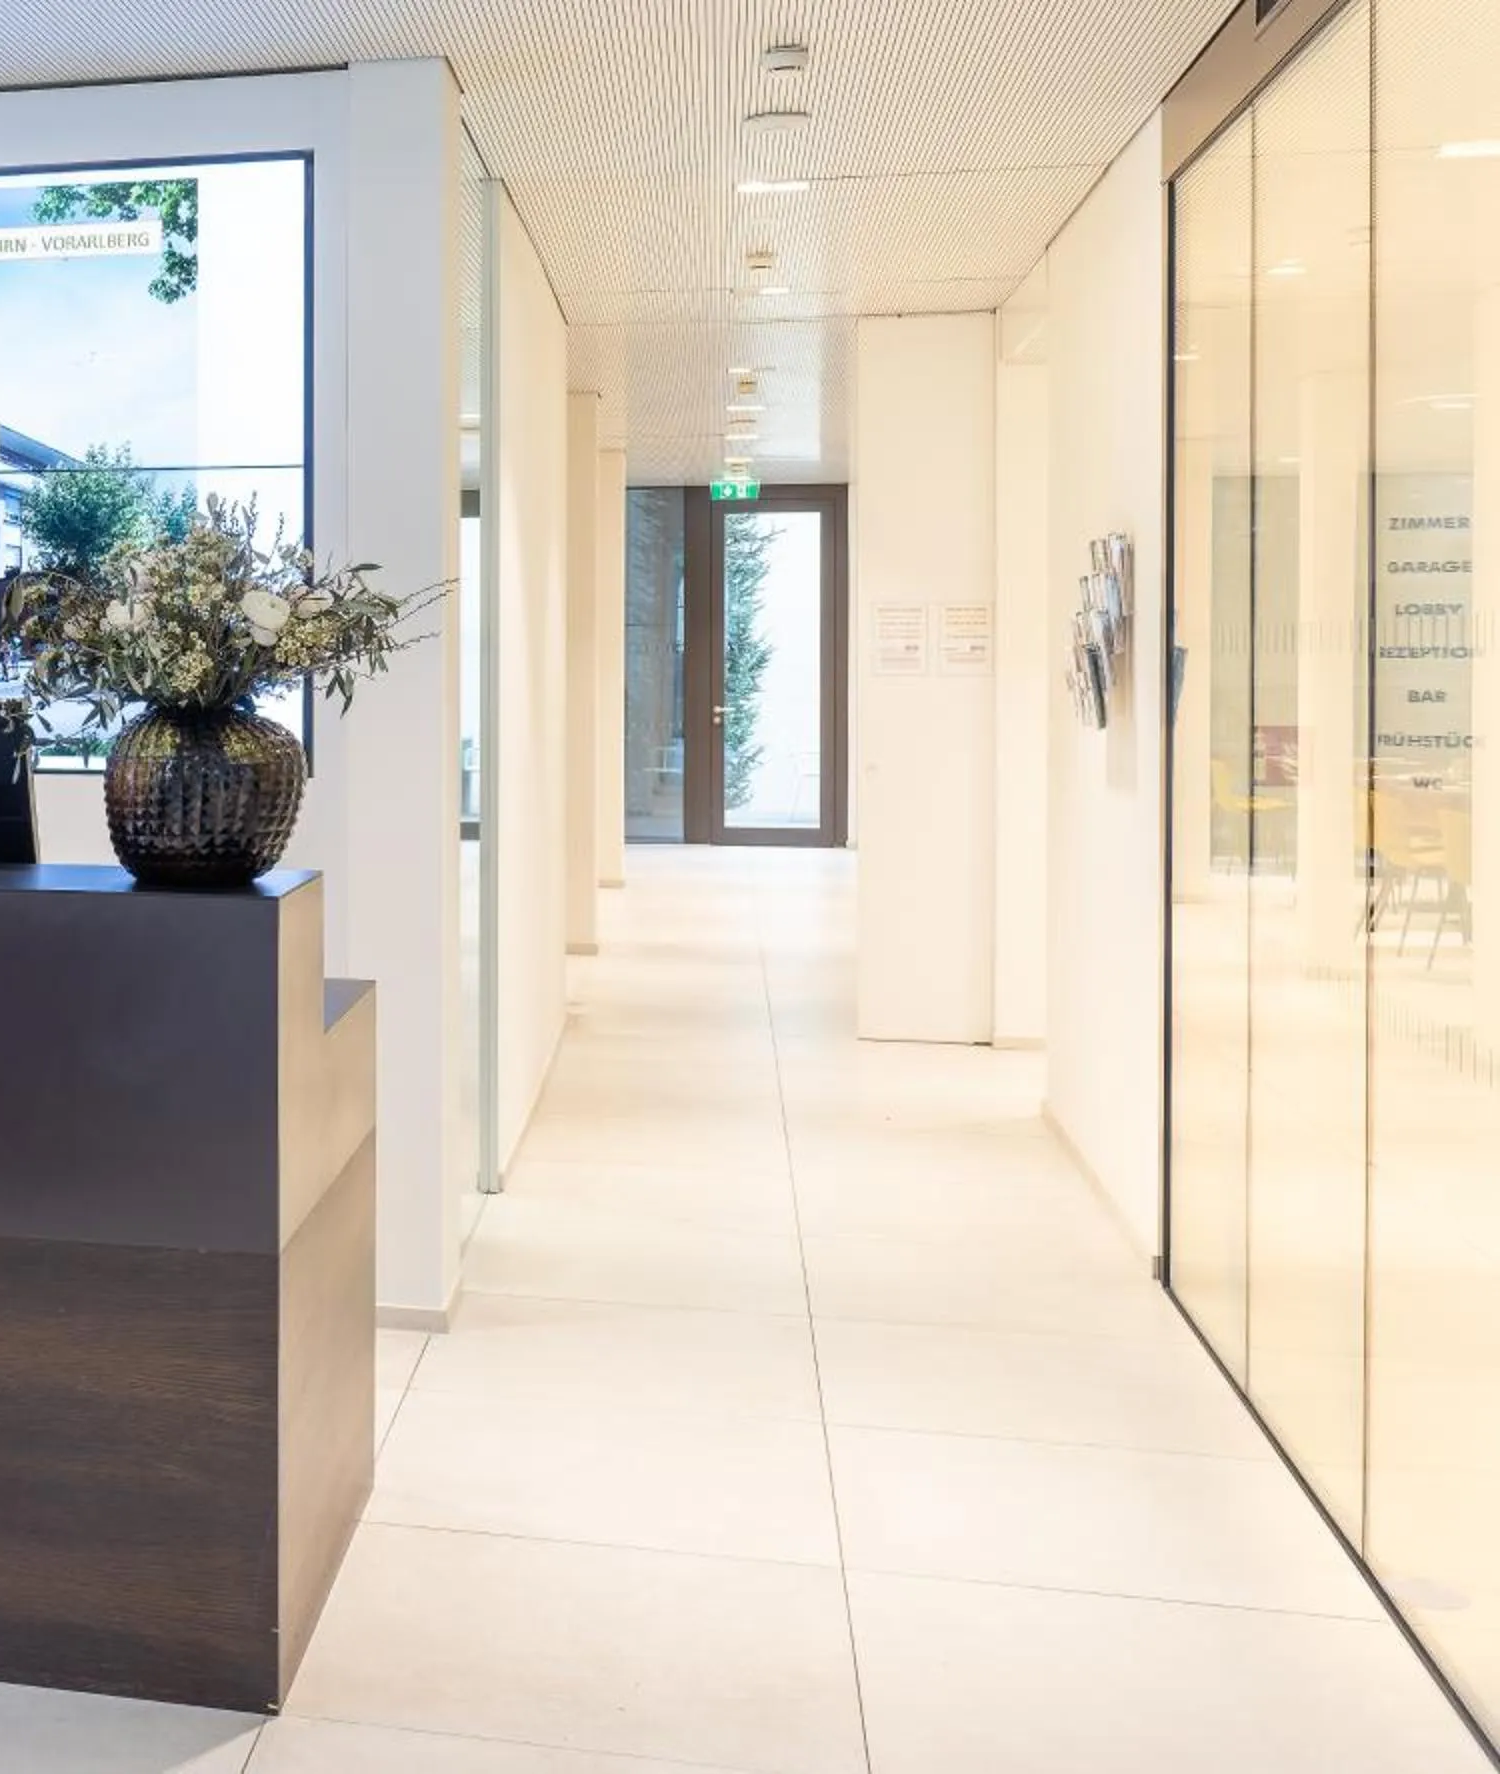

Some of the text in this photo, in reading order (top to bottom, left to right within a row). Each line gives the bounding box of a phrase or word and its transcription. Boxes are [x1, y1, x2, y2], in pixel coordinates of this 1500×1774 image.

[41, 232, 150, 252] VORARLBERG
[1388, 516, 1470, 531] ZIMMER
[1387, 560, 1473, 574] GARAGE
[1395, 602, 1463, 616] LOBBY
[1407, 688, 1448, 704] BAR
[1377, 729, 1485, 750] FRÜHSTÜC
[1412, 776, 1443, 790] WC
